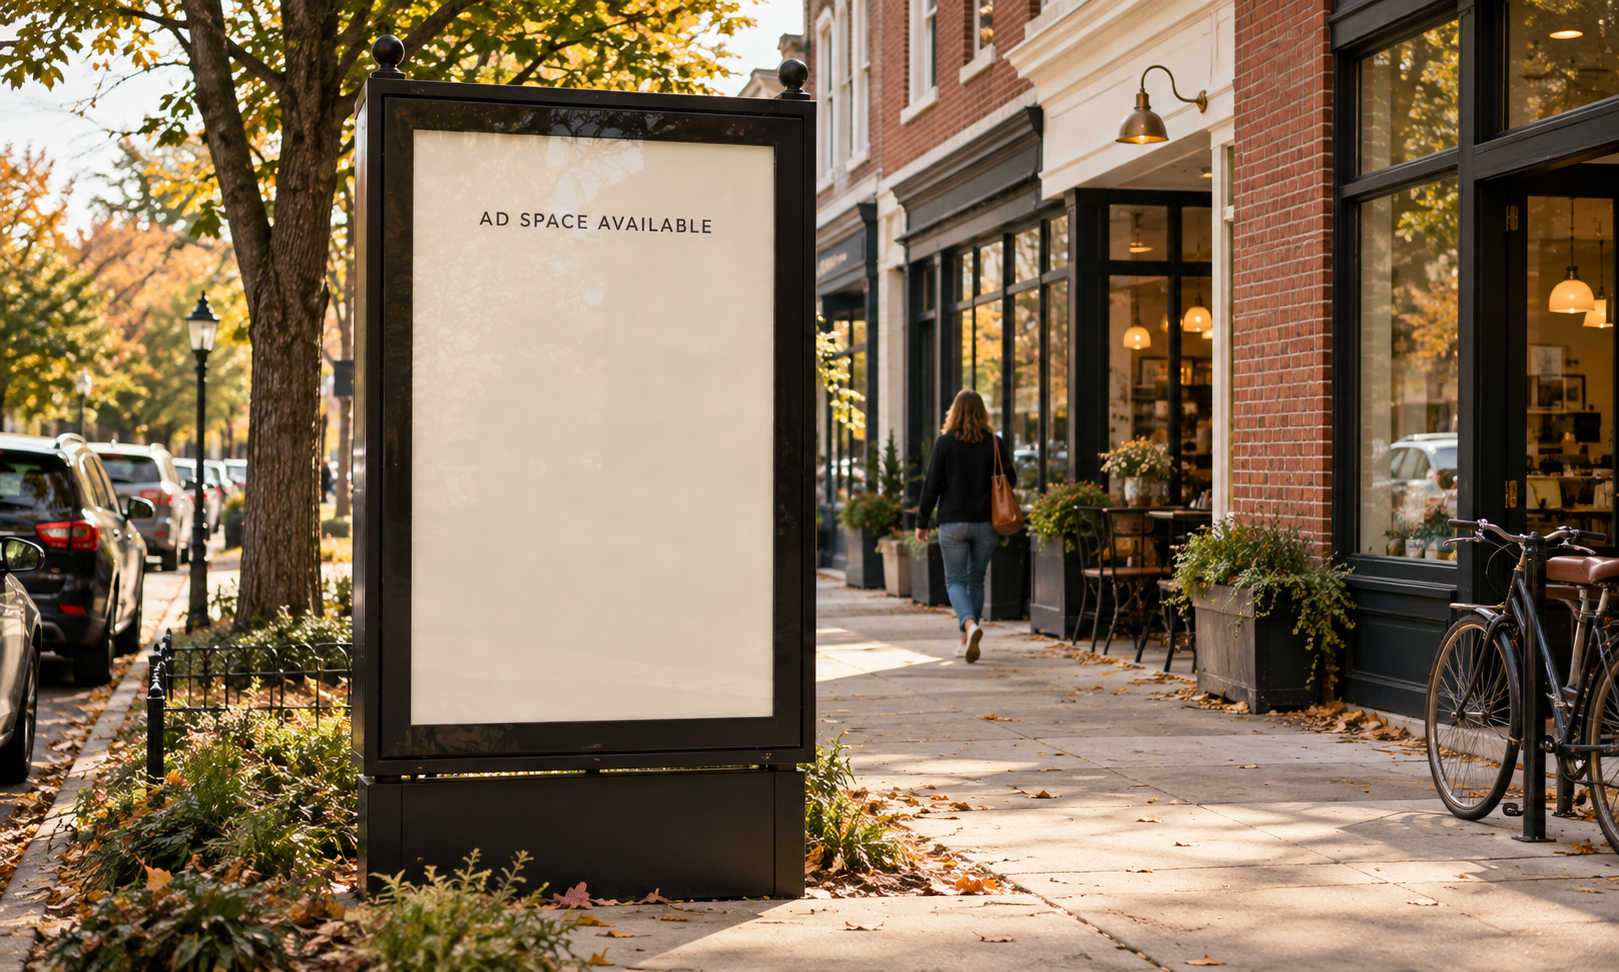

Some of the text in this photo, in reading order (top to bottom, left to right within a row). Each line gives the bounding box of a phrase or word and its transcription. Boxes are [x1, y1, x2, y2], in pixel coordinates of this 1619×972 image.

[479, 210, 712, 233] AD SPACE AVAILABLE
